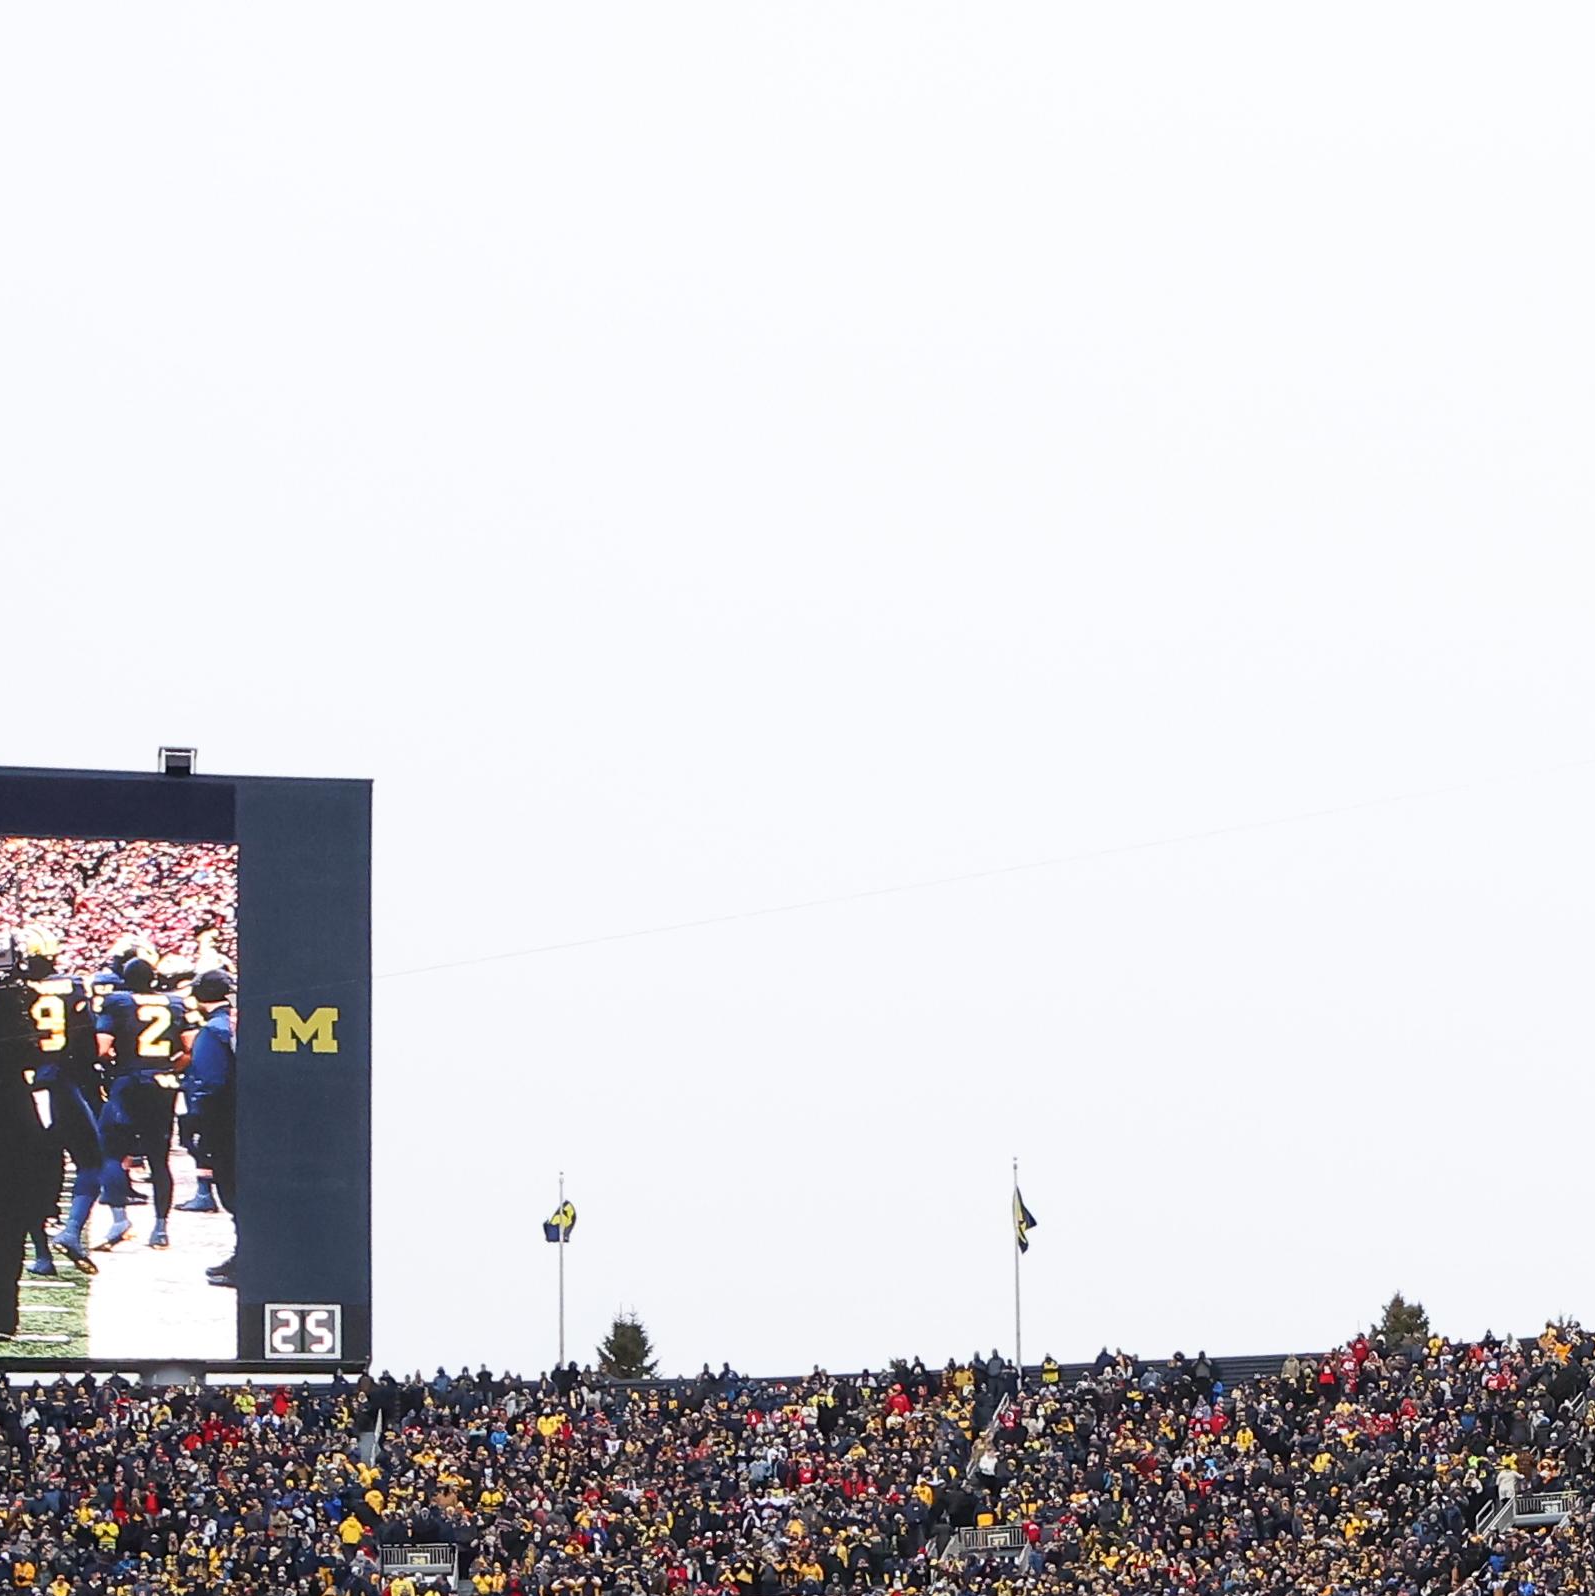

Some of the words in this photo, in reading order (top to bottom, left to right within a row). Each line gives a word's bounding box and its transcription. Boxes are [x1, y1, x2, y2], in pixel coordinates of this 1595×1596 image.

[30, 994, 67, 1051] 9
[137, 1004, 172, 1057] 2
[271, 1006, 339, 1053] M
[272, 1310, 333, 1352] 25
